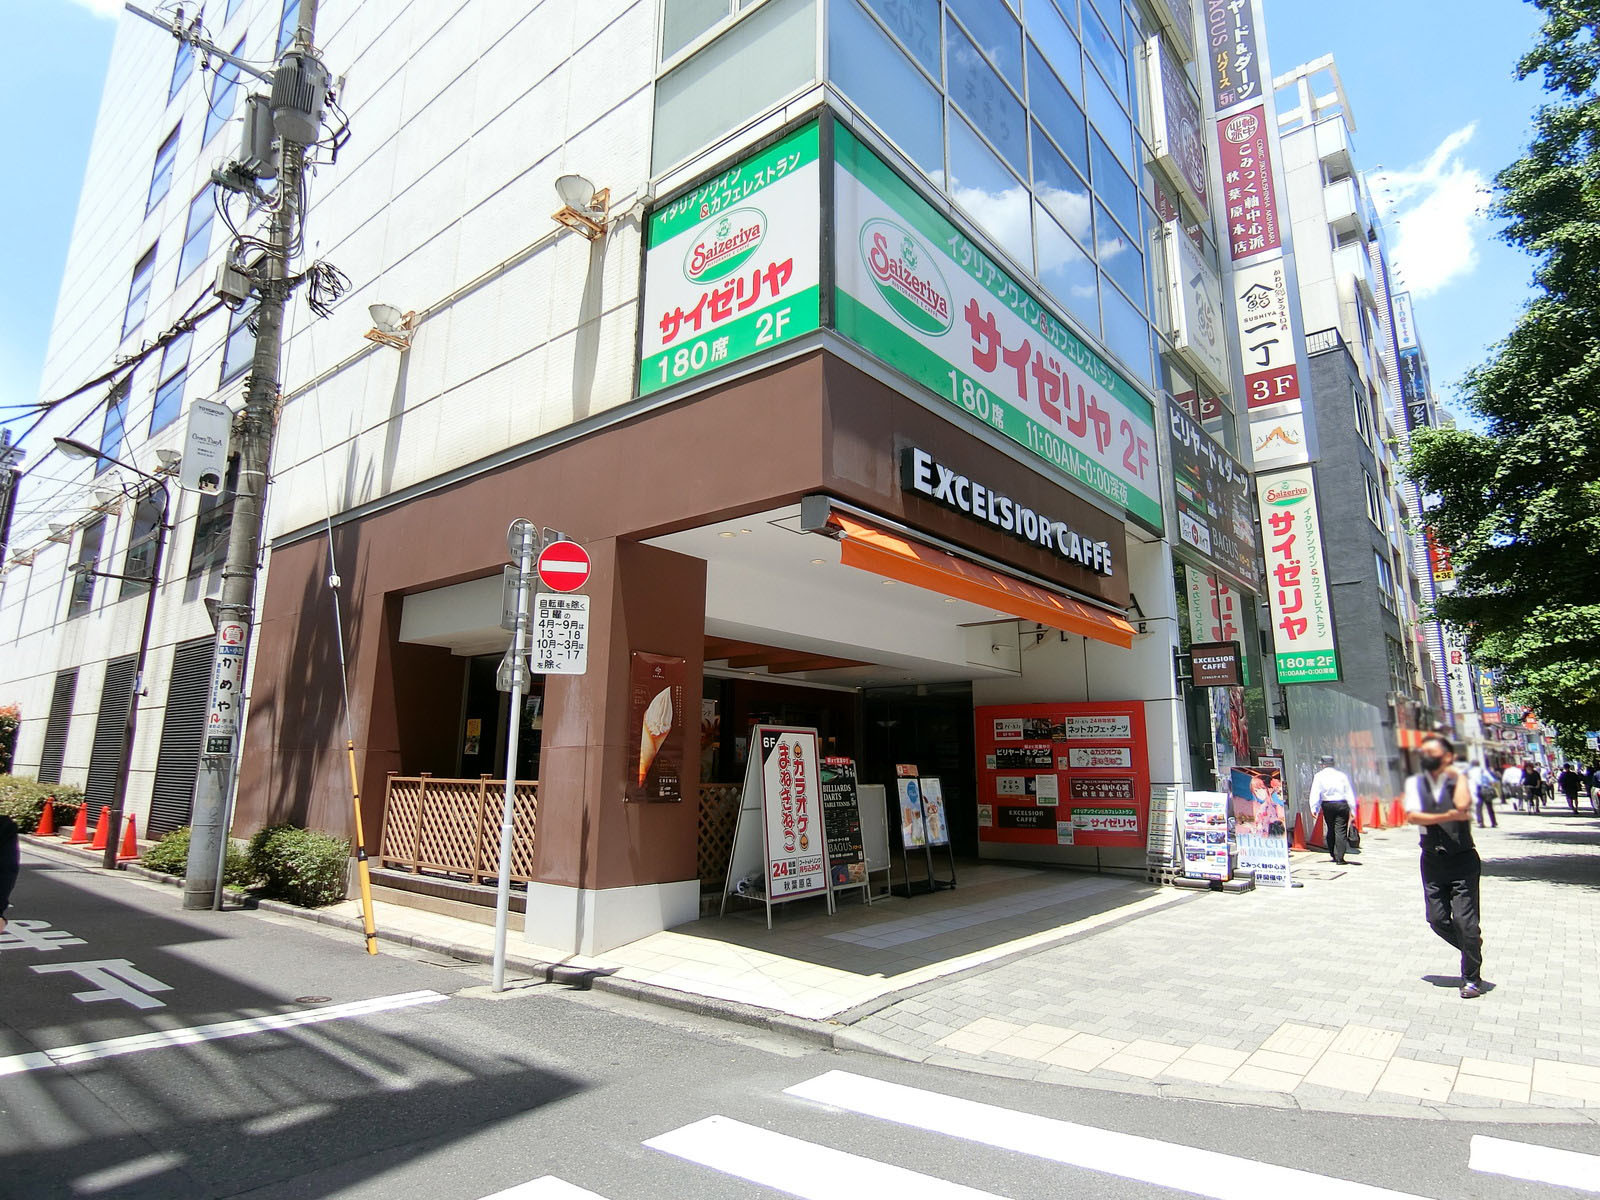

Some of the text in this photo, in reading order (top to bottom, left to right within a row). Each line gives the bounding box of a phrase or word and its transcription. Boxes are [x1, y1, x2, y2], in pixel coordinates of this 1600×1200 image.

[1217, 51, 1231, 89] バグース
[1219, 92, 1234, 106] 5F
[660, 167, 742, 225] イタリアンワイン
[1239, 143, 1265, 250] こみっく軸中心派
[1226, 170, 1247, 255] 秋葉原本店
[691, 224, 761, 272] Saizeriya
[869, 232, 948, 315] Saizeriya
[659, 257, 793, 345] サイゼリヤ
[947, 233, 1116, 391] イタリアンワイン&カフェレストラン
[1243, 311, 1277, 323] SUSHIYA
[658, 307, 791, 384] 180席 2F
[1244, 321, 1279, 367] 一丁
[948, 370, 1005, 430] 180席
[964, 297, 1149, 481] サイゼリヤ 2F
[1253, 374, 1294, 401] 3F
[1169, 405, 1249, 498] ビリヤード&ダーツ
[913, 447, 1053, 549] EXCELSIOR
[1266, 487, 1309, 502] Saizeriya
[1211, 526, 1239, 561] BAGUS
[1267, 510, 1308, 641] サイゼリヤ
[539, 599, 585, 609] 自転車を除く
[540, 609, 571, 619] 日曜の
[537, 659, 562, 669] を除く
[1193, 655, 1235, 664] EXCELSIOR
[1316, 655, 1334, 667] 2F
[217, 656, 238, 712] かめや
[763, 737, 776, 748] 6F
[1068, 725, 1129, 734] ネットカフェ・ダーツ
[1090, 757, 1123, 766] まねきねこ
[776, 742, 797, 853] まねきねこ
[793, 758, 809, 835] カラオケ
[822, 783, 852, 793] BILLIARDS
[823, 792, 842, 801] DARTS
[1008, 809, 1044, 817] EXCELSIOR
[1090, 817, 1137, 828] サイゼリヤ
[828, 841, 853, 853] BAGUS
[772, 862, 789, 878] 24
[783, 877, 812, 891] 秋葉原店
